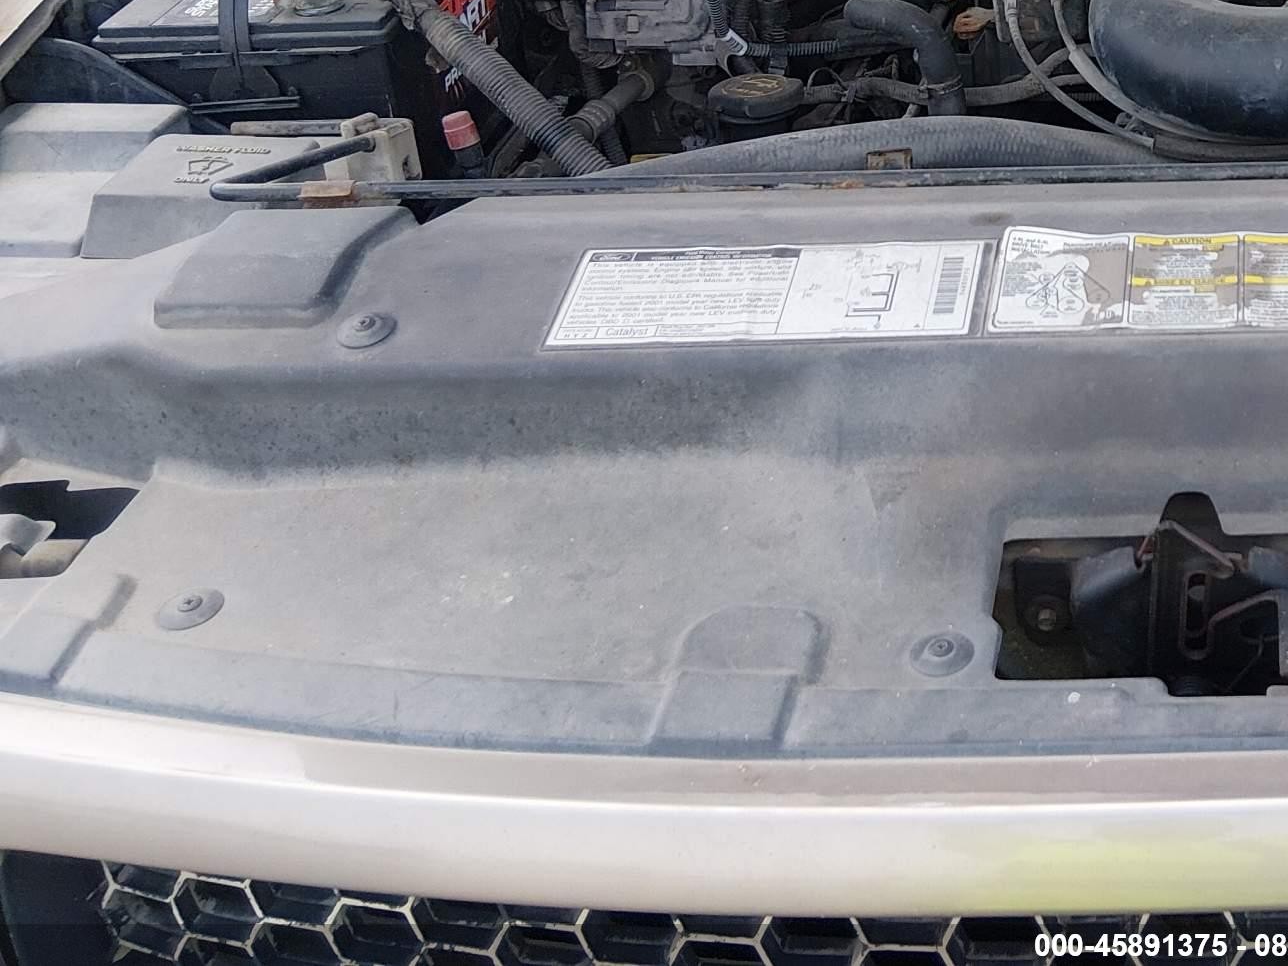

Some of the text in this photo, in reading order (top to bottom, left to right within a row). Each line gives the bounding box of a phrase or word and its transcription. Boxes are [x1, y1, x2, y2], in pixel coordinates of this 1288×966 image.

[233, 146, 272, 154] FLUID
[1171, 236, 1212, 244] CAUTION
[605, 327, 649, 337] Catalyst
